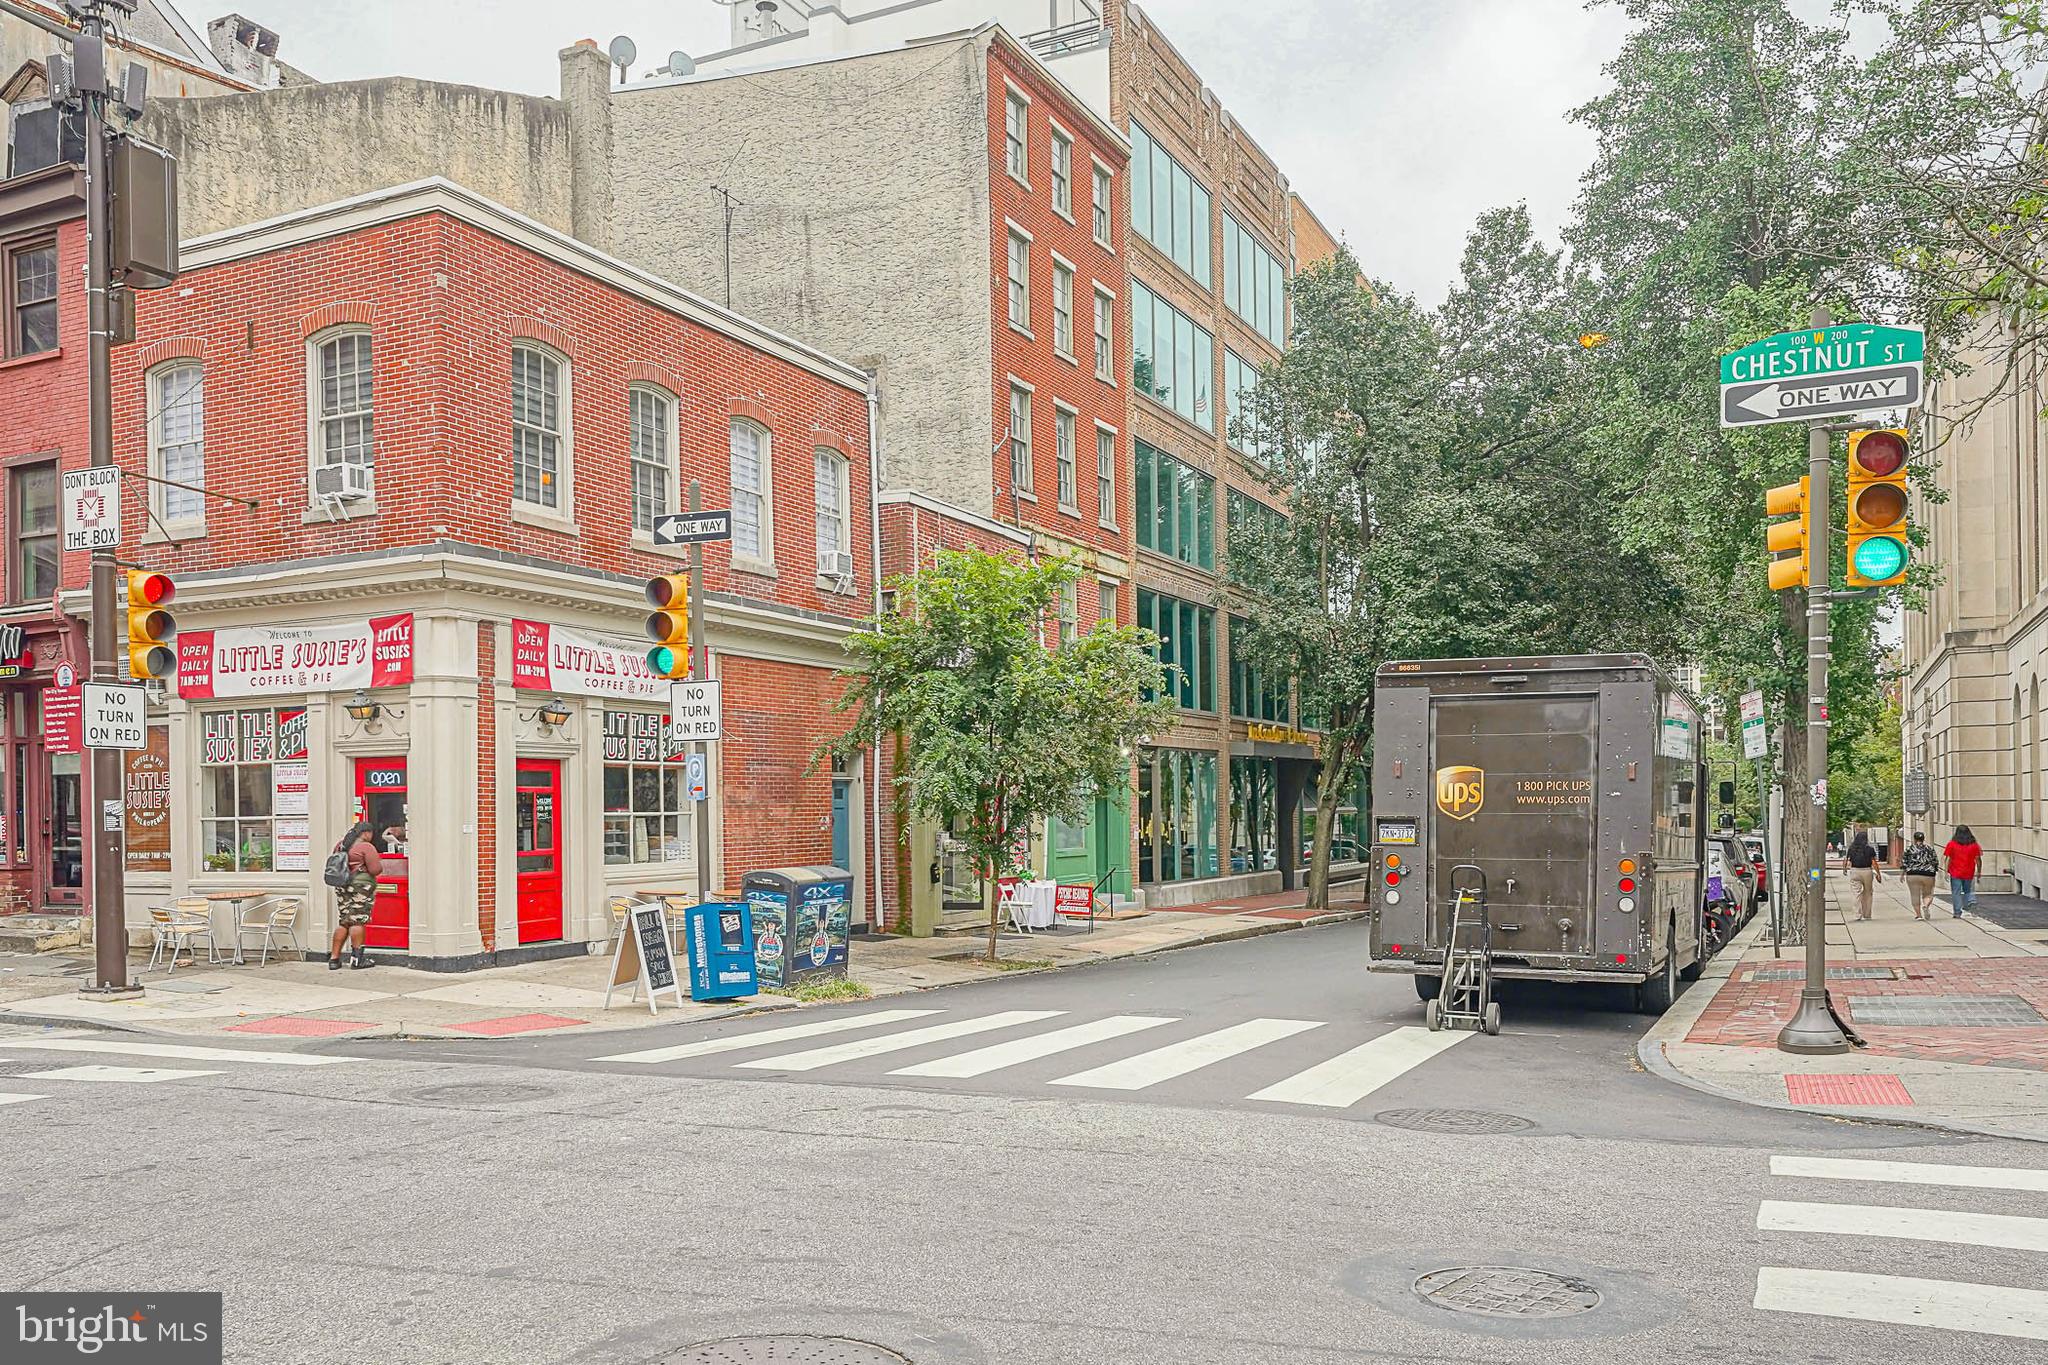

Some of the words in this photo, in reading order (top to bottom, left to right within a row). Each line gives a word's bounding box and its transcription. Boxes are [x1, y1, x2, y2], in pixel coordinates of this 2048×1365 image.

[1791, 335, 1806, 345] 100
[1813, 332, 1824, 344] W
[1831, 330, 1848, 341] 200
[1732, 340, 1869, 380] CHESTNUT
[1884, 343, 1905, 362] ST
[1780, 388, 1830, 407] ONE
[1840, 380, 1896, 400] WAY
[65, 474, 87, 489] DONT
[90, 470, 116, 486] BLOCK
[676, 522, 696, 534] ONE
[700, 520, 722, 532] WAY
[67, 531, 87, 547] THE
[93, 528, 115, 545] BOX
[268, 630, 300, 640] WELCOME
[378, 626, 410, 642] LITTLE
[518, 633, 543, 646] OPEN
[182, 645, 208, 657] OPEN
[219, 645, 284, 673] LITTLE
[291, 638, 367, 669] SUSIE'S
[376, 645, 410, 661] SUSIES
[517, 649, 544, 662] DAILY
[181, 660, 209, 671] DAILY
[385, 662, 401, 673] .COM
[554, 644, 616, 676] LITTLE
[517, 664, 546, 678] 7AM-2PM
[180, 674, 208, 687] 7AM-2PM
[250, 675, 294, 686] COFFEE
[298, 672, 306, 686] &
[313, 672, 331, 683] PIE
[584, 678, 623, 691] COFFEE
[628, 680, 635, 693] &
[640, 684, 653, 693] PIE
[105, 692, 126, 705] NO
[687, 688, 704, 700] NO
[98, 710, 133, 723] TURN
[682, 705, 710, 717] TURN
[206, 713, 272, 739] LITTLE
[280, 711, 308, 737] COFFE
[603, 712, 658, 737] ITTLE
[676, 723, 690, 734] ON
[696, 722, 716, 733] RED
[90, 727, 108, 740] ON
[116, 729, 140, 741] RED
[206, 739, 272, 762] SUSIE'S
[279, 739, 290, 759] &
[292, 730, 305, 755] PI
[128, 772, 170, 790] LITTLE
[371, 772, 400, 787] open
[1516, 782, 1521, 790] 1
[1524, 782, 1543, 791] 800
[1546, 781, 1568, 790] PICK
[1572, 781, 1591, 790] UPS
[127, 791, 170, 809] SUSIE'S
[1440, 782, 1480, 812] ups
[1516, 795, 1591, 806] www.ups.com
